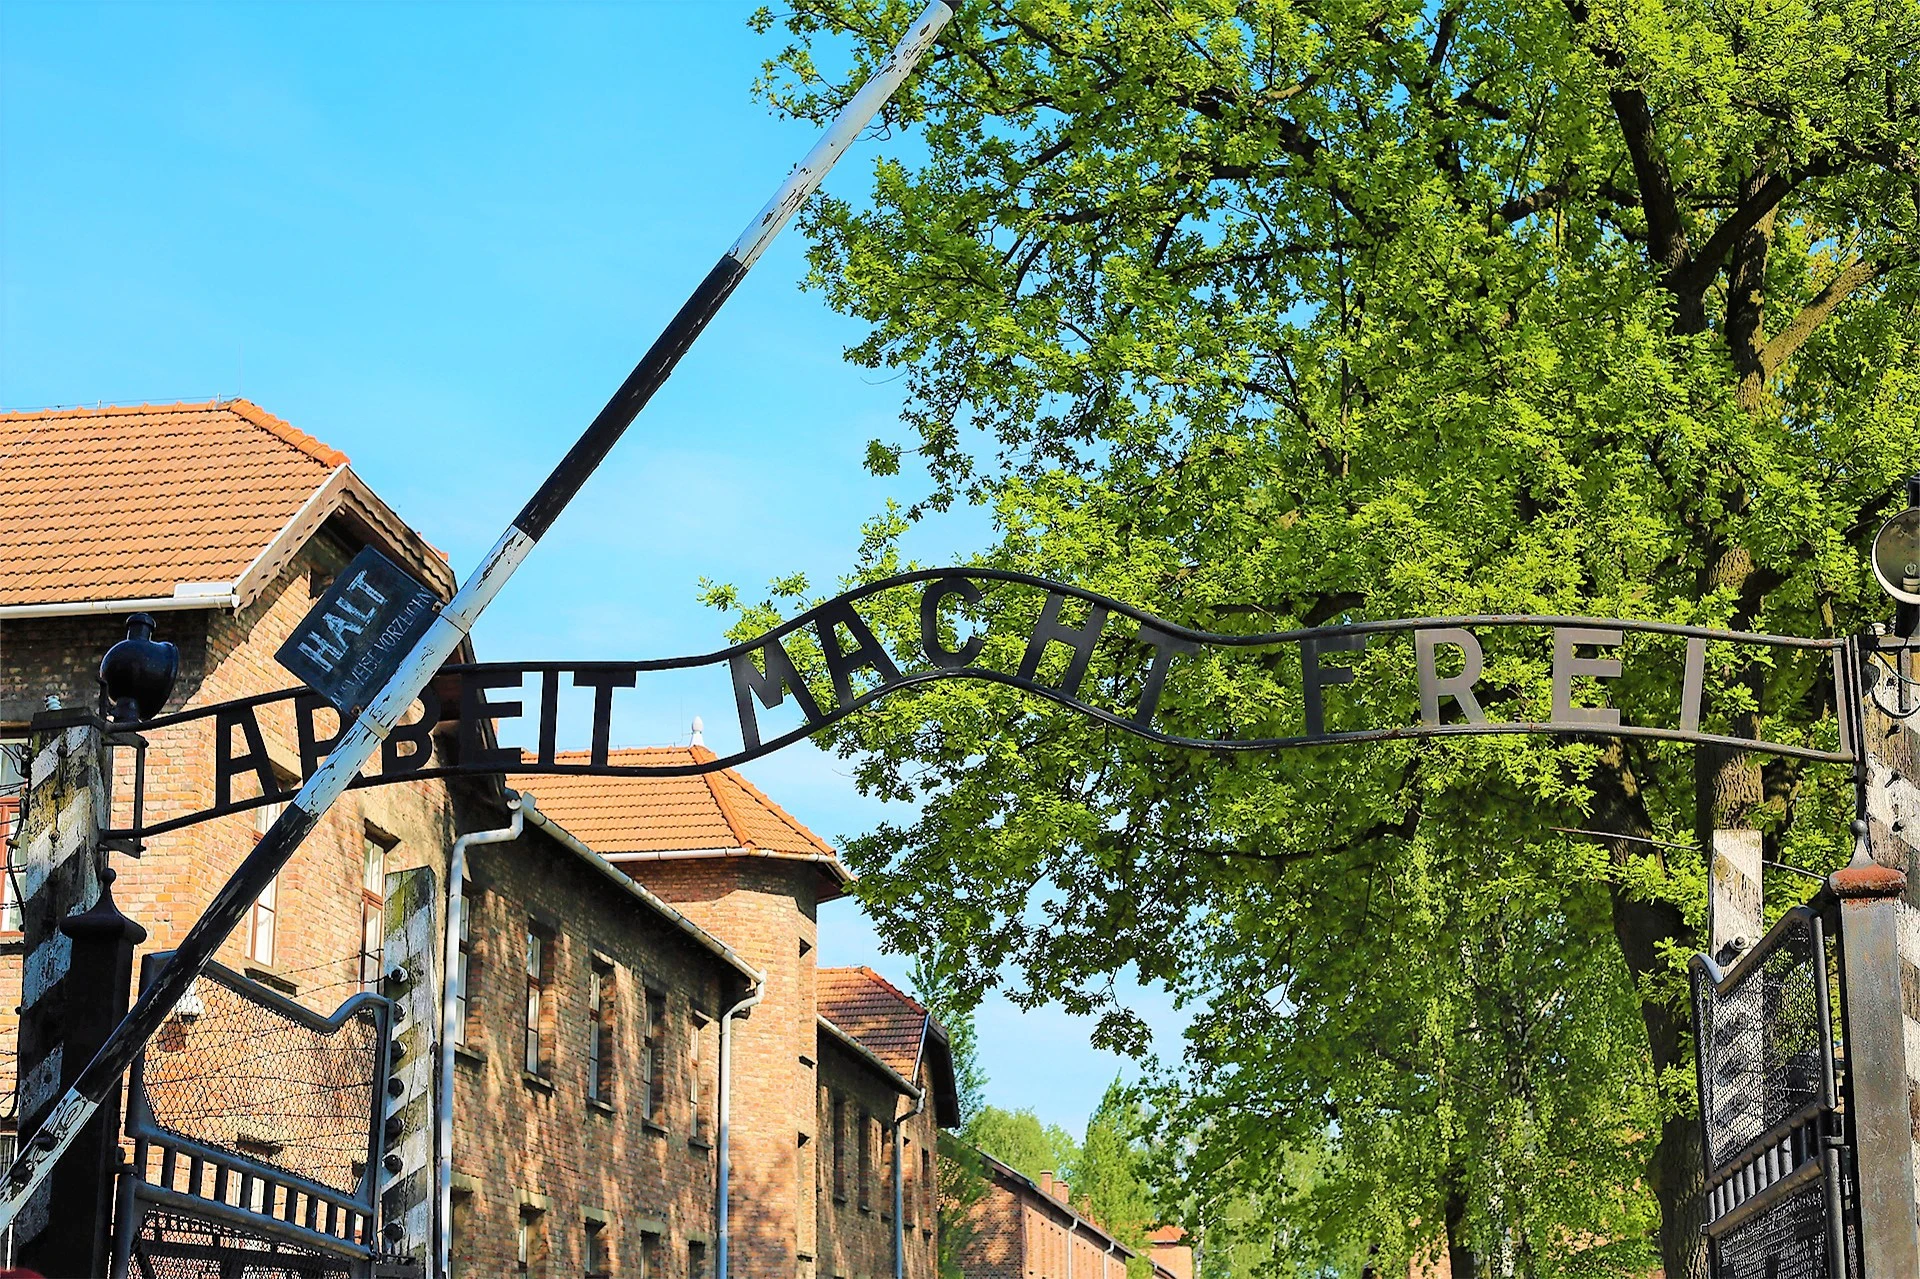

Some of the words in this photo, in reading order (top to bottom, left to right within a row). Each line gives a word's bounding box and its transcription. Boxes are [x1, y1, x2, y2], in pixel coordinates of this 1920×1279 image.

[214, 668, 636, 807] ARBEIT
[729, 576, 1200, 750] MACHT
[1300, 625, 1706, 736] FREI
[297, 569, 388, 673] HALT
